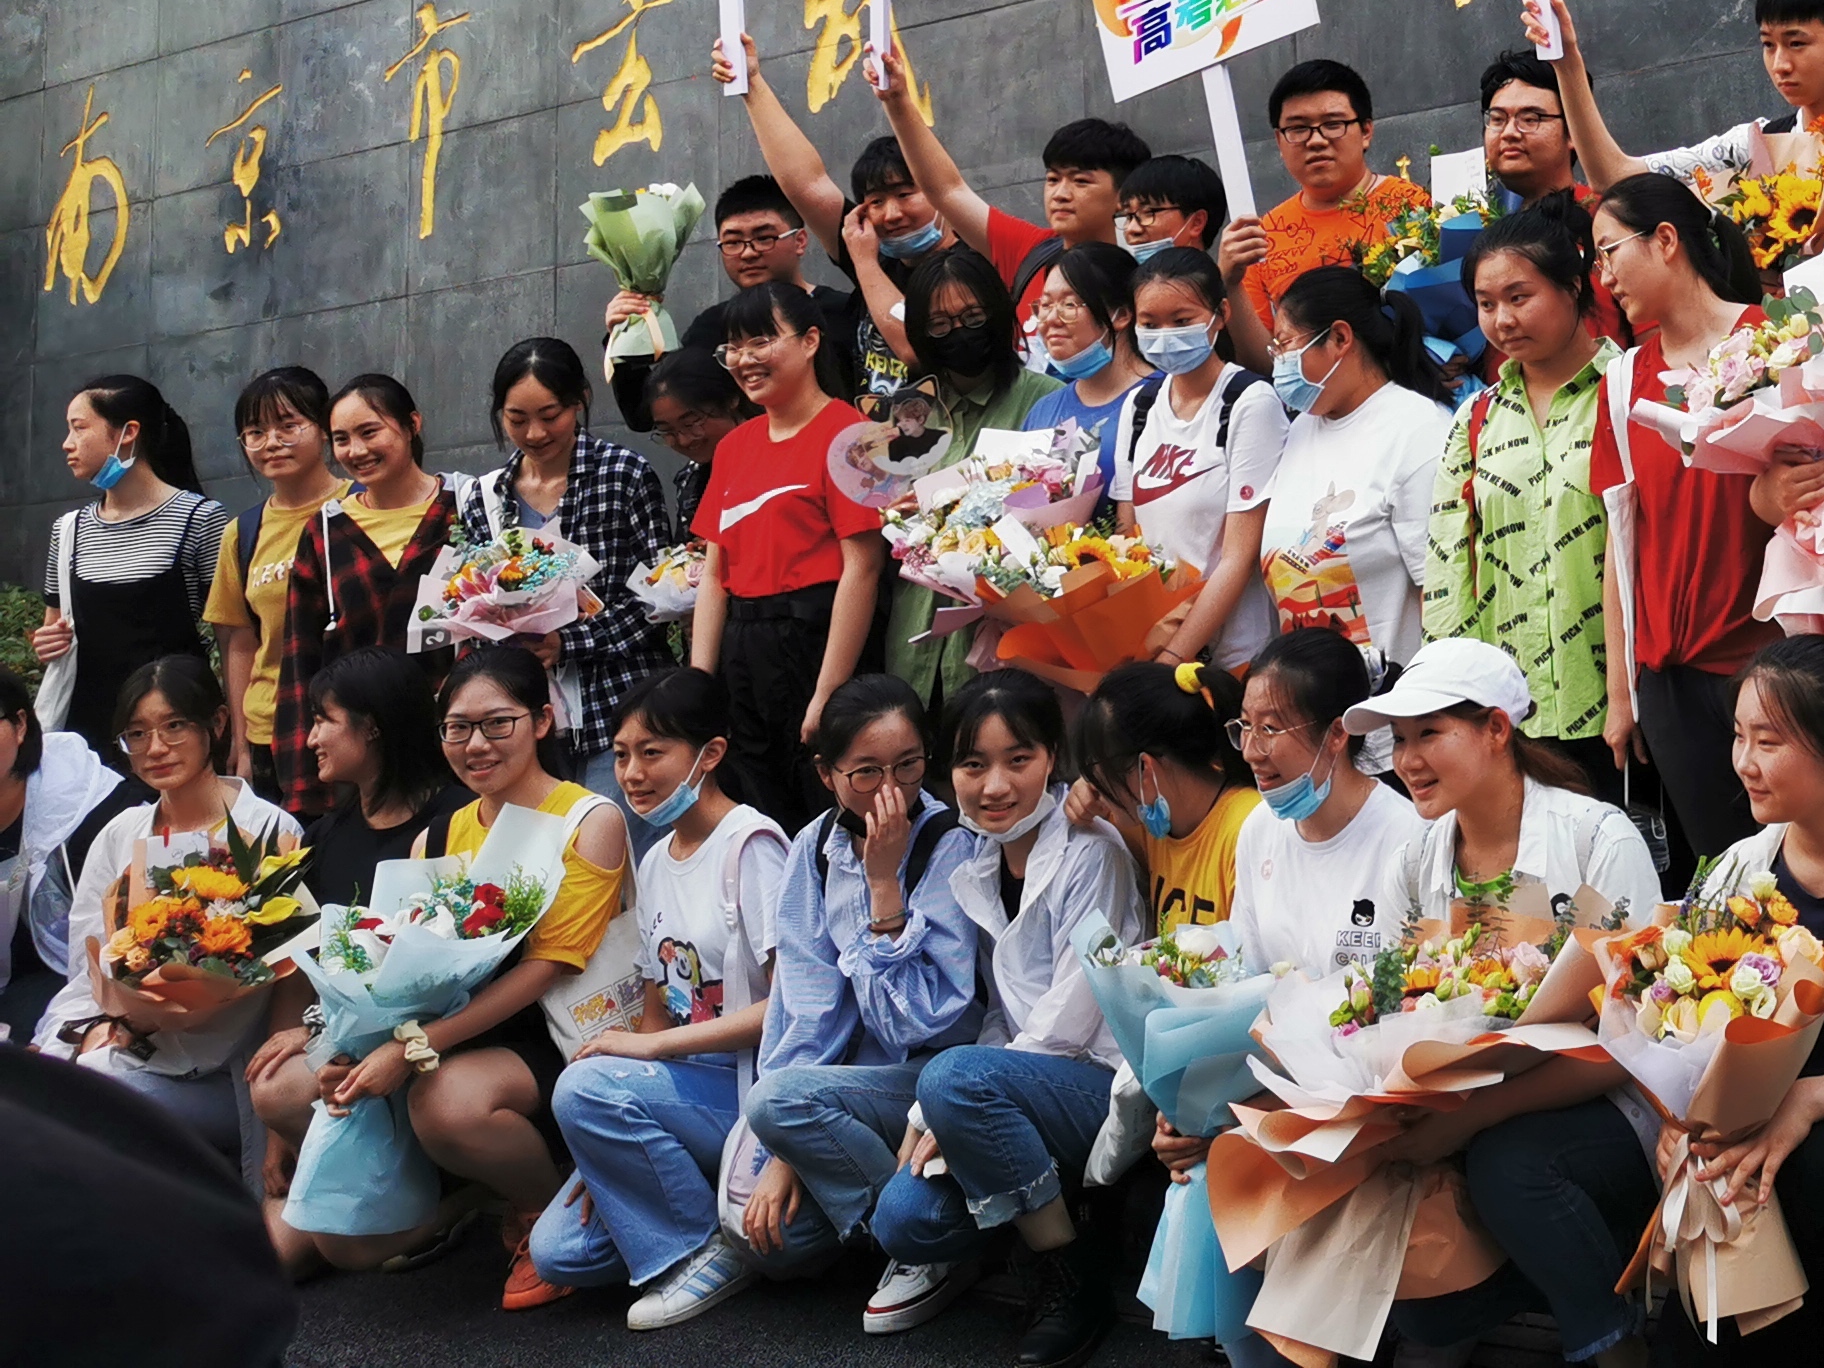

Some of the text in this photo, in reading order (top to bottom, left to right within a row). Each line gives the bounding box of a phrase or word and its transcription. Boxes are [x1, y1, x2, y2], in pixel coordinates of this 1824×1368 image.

[1508, 436, 1529, 449] NOW
[1499, 478, 1522, 498] NOW
[1553, 514, 1602, 552] PICK ME NOW
[1566, 711, 1587, 736] PICK
